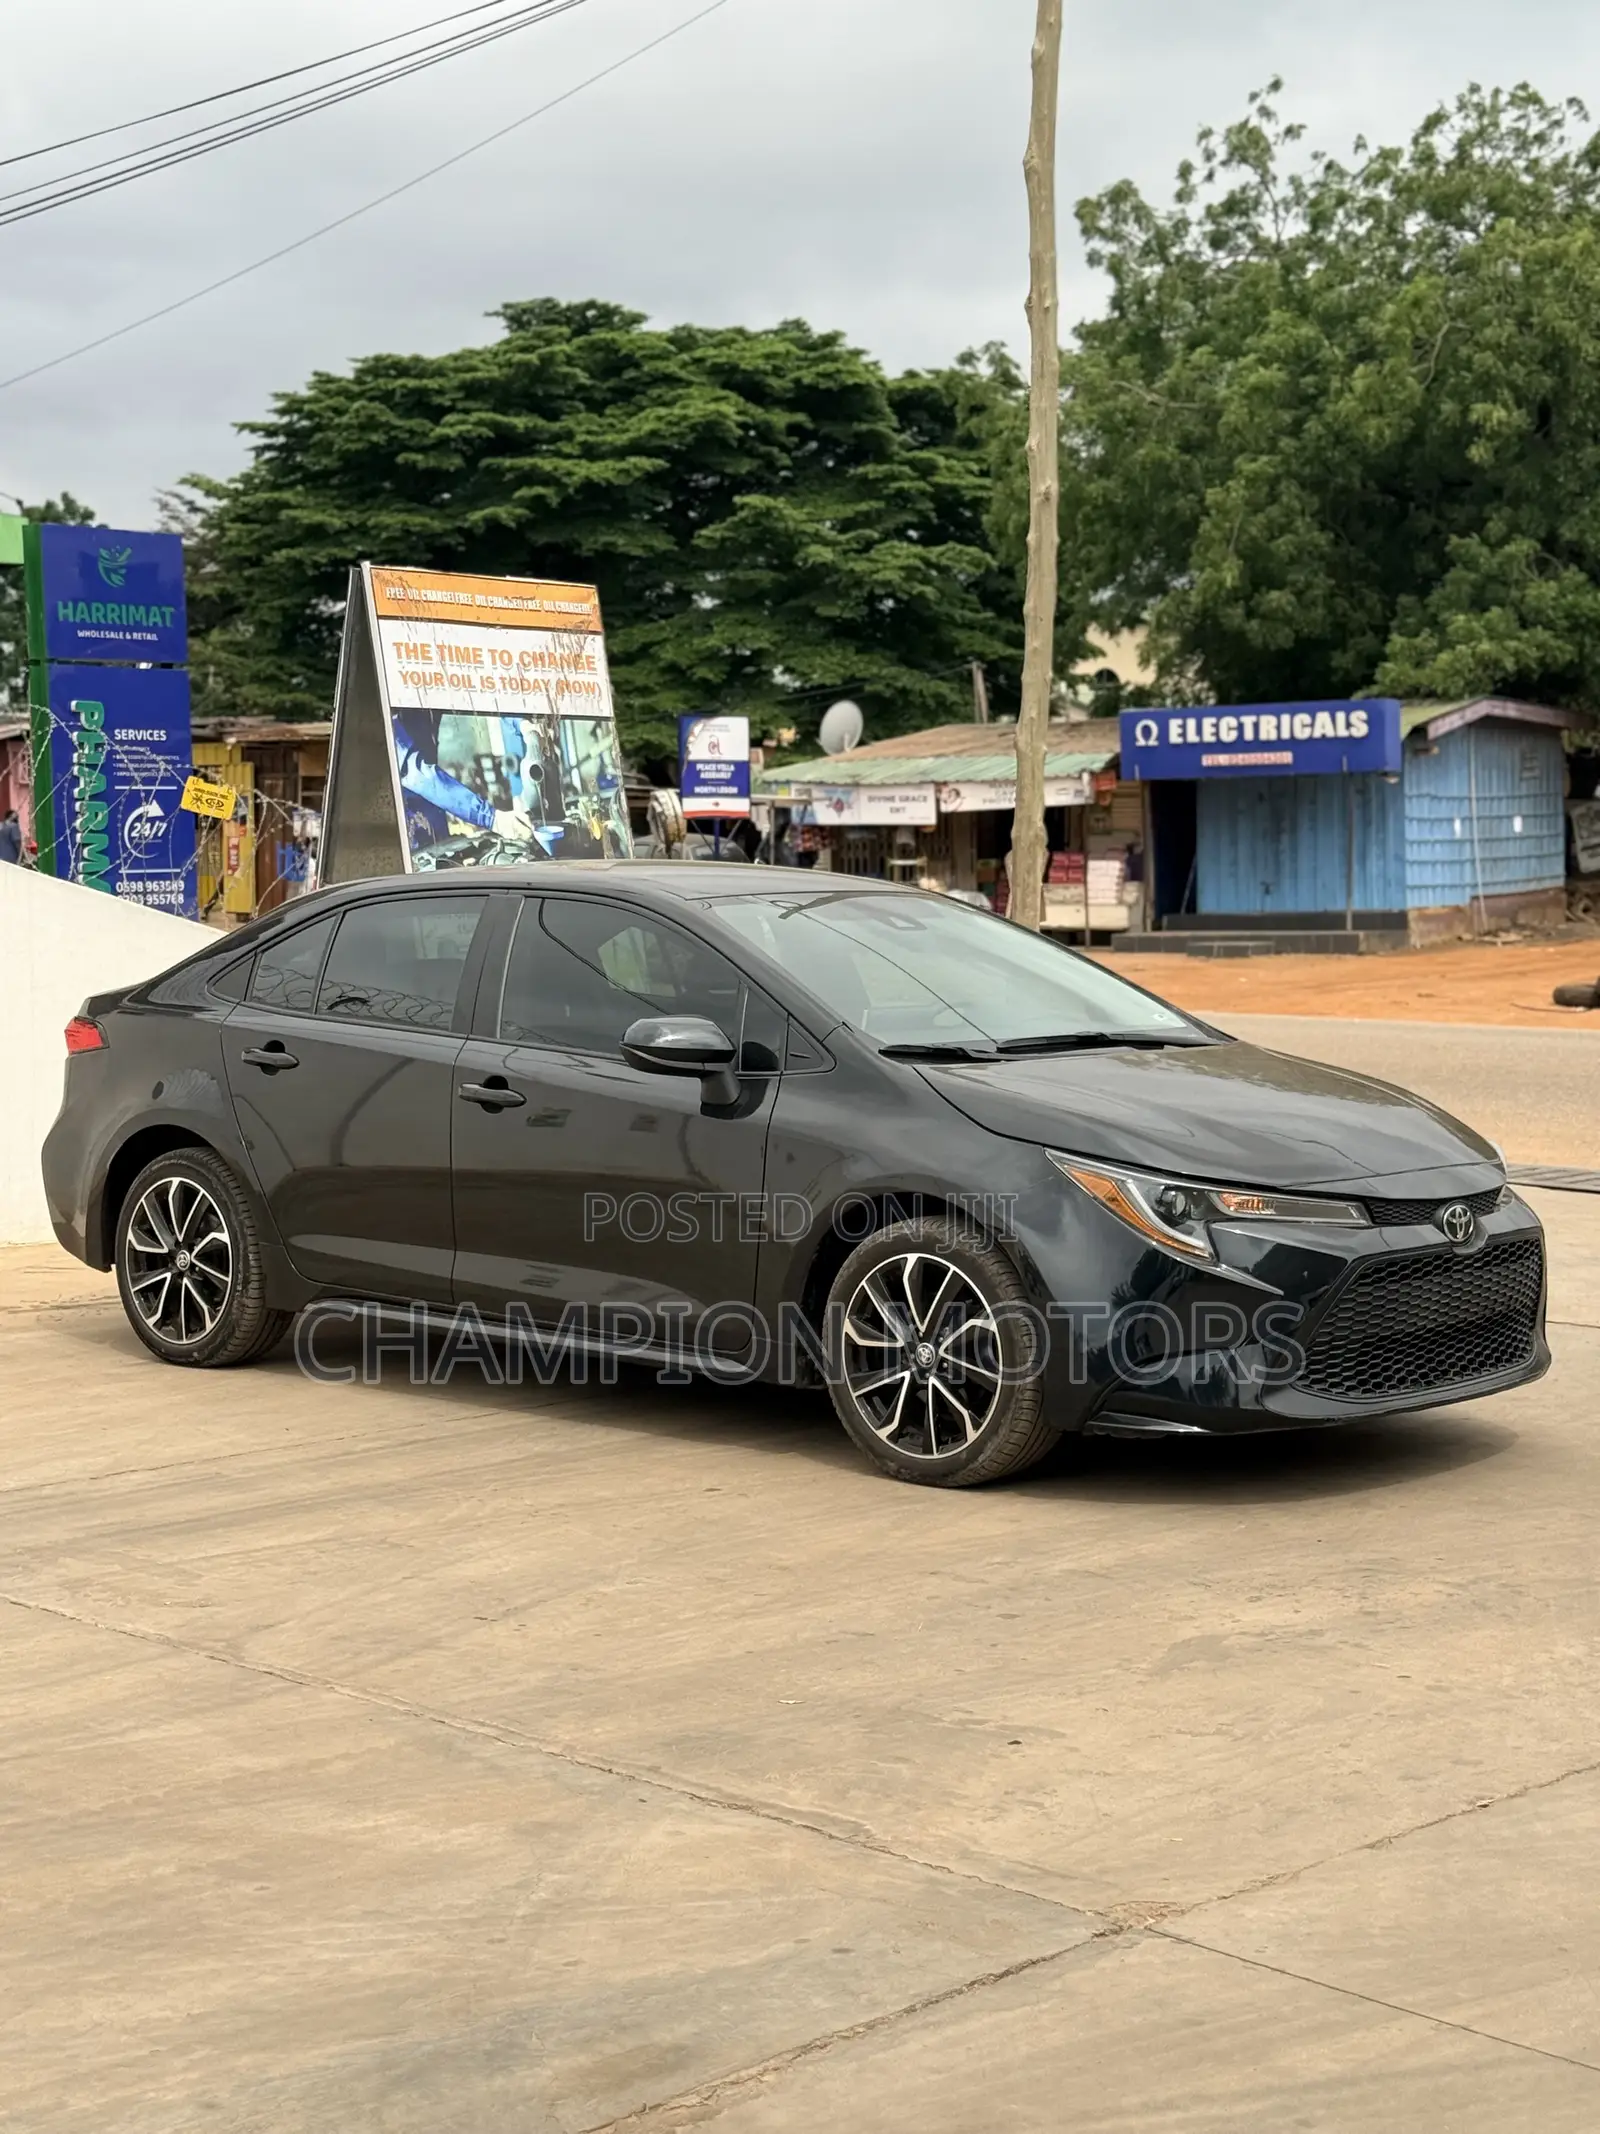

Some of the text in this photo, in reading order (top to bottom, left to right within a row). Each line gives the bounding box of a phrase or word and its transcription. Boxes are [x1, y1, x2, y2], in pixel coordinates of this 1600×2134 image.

[385, 587, 406, 599] FREE
[455, 592, 473, 605] FREE
[57, 600, 175, 628] HARRIMAT
[77, 629, 159, 641] WHOLESALE & RETAIL
[392, 642, 597, 673] THE TIME TO CHANGE
[398, 670, 602, 698] YOUR OIL IS TODAY (NOW)
[114, 728, 168, 741] SERVICES
[1168, 709, 1370, 745] ELECTRICALS
[898, 795, 928, 803] GRACE
[131, 820, 168, 839] 24/7
[115, 881, 144, 893] 0598
